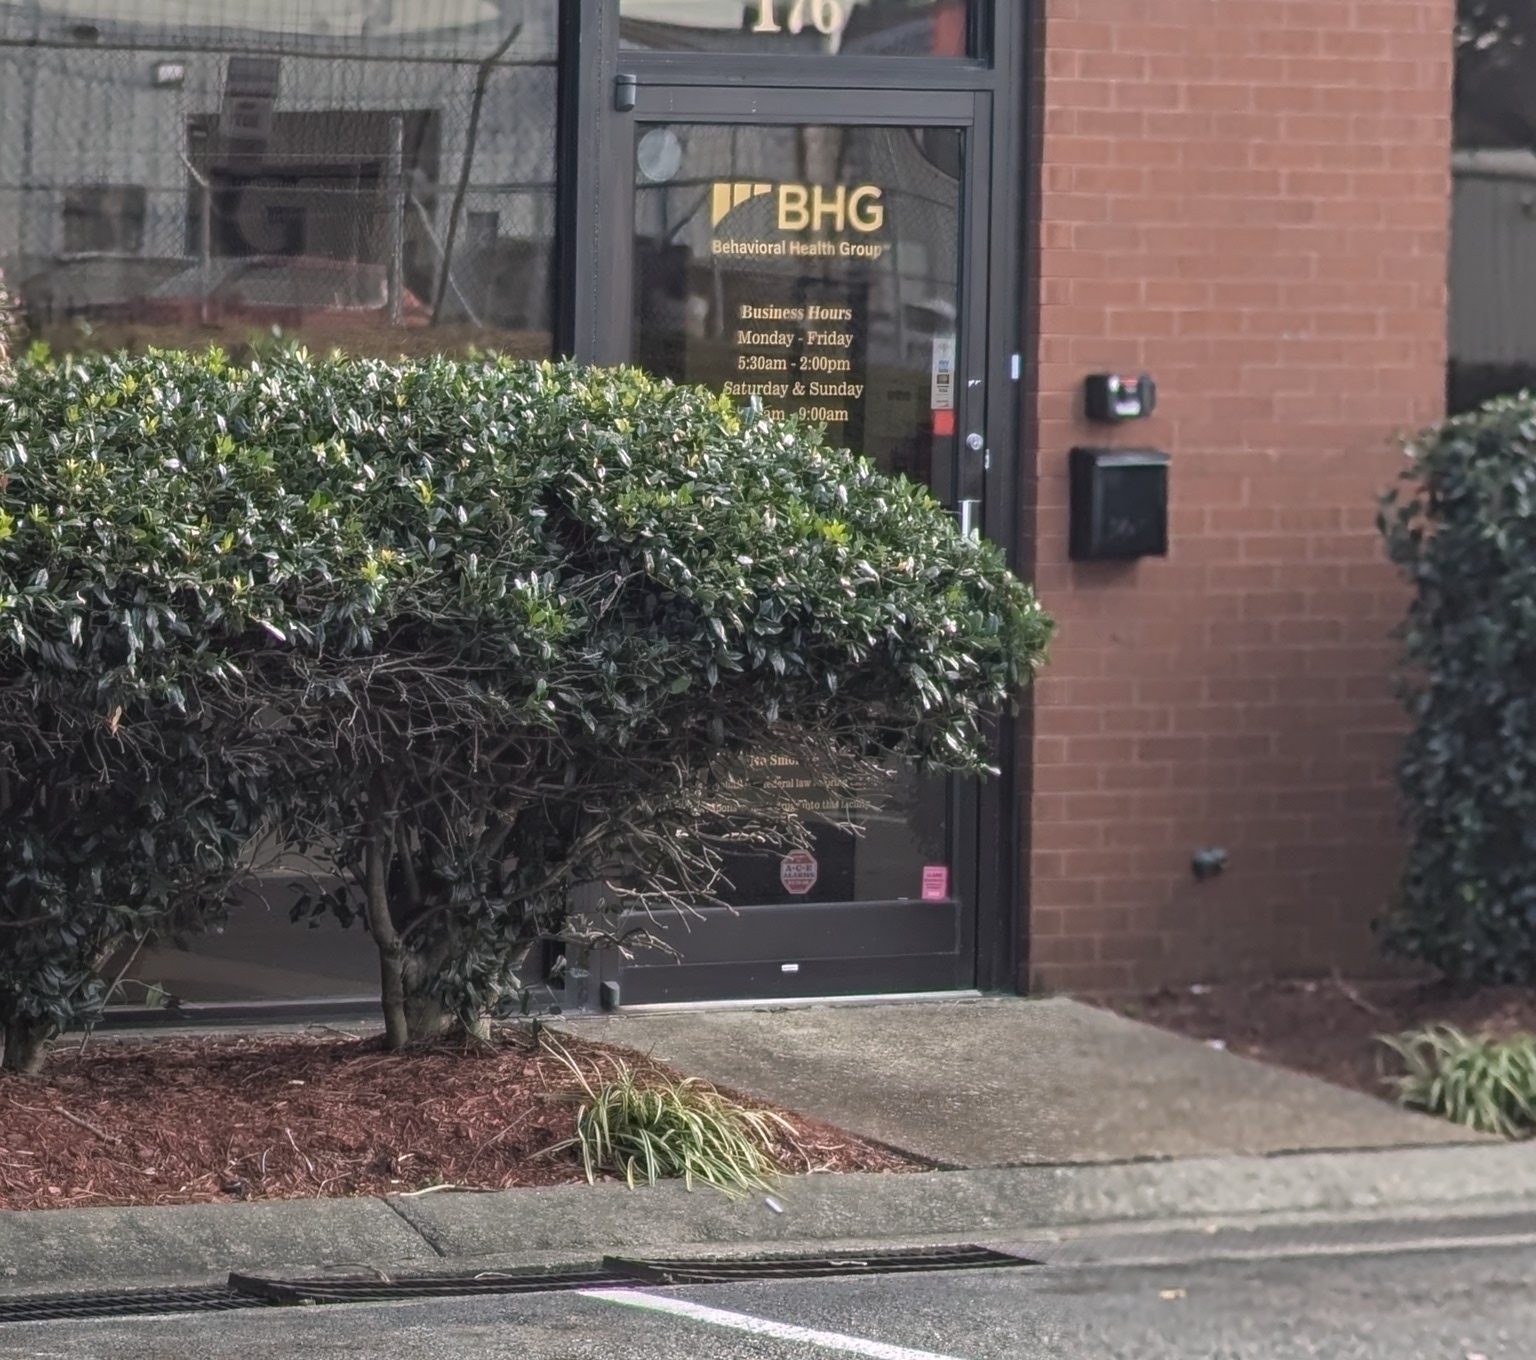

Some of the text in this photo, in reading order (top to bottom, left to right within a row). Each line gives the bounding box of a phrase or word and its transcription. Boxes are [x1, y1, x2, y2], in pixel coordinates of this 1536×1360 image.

[778, 184, 883, 232] BHG
[713, 239, 882, 259] Behavioral Health Group
[742, 304, 852, 320] Business Hours
[737, 330, 794, 348] Monday
[807, 330, 854, 348] Friday
[738, 355, 787, 371] 5:30am
[799, 356, 851, 373] 2:00pm
[723, 381, 864, 399] Saturday & Sunday
[799, 407, 849, 421] 9:00am
[795, 778, 811, 788] law
